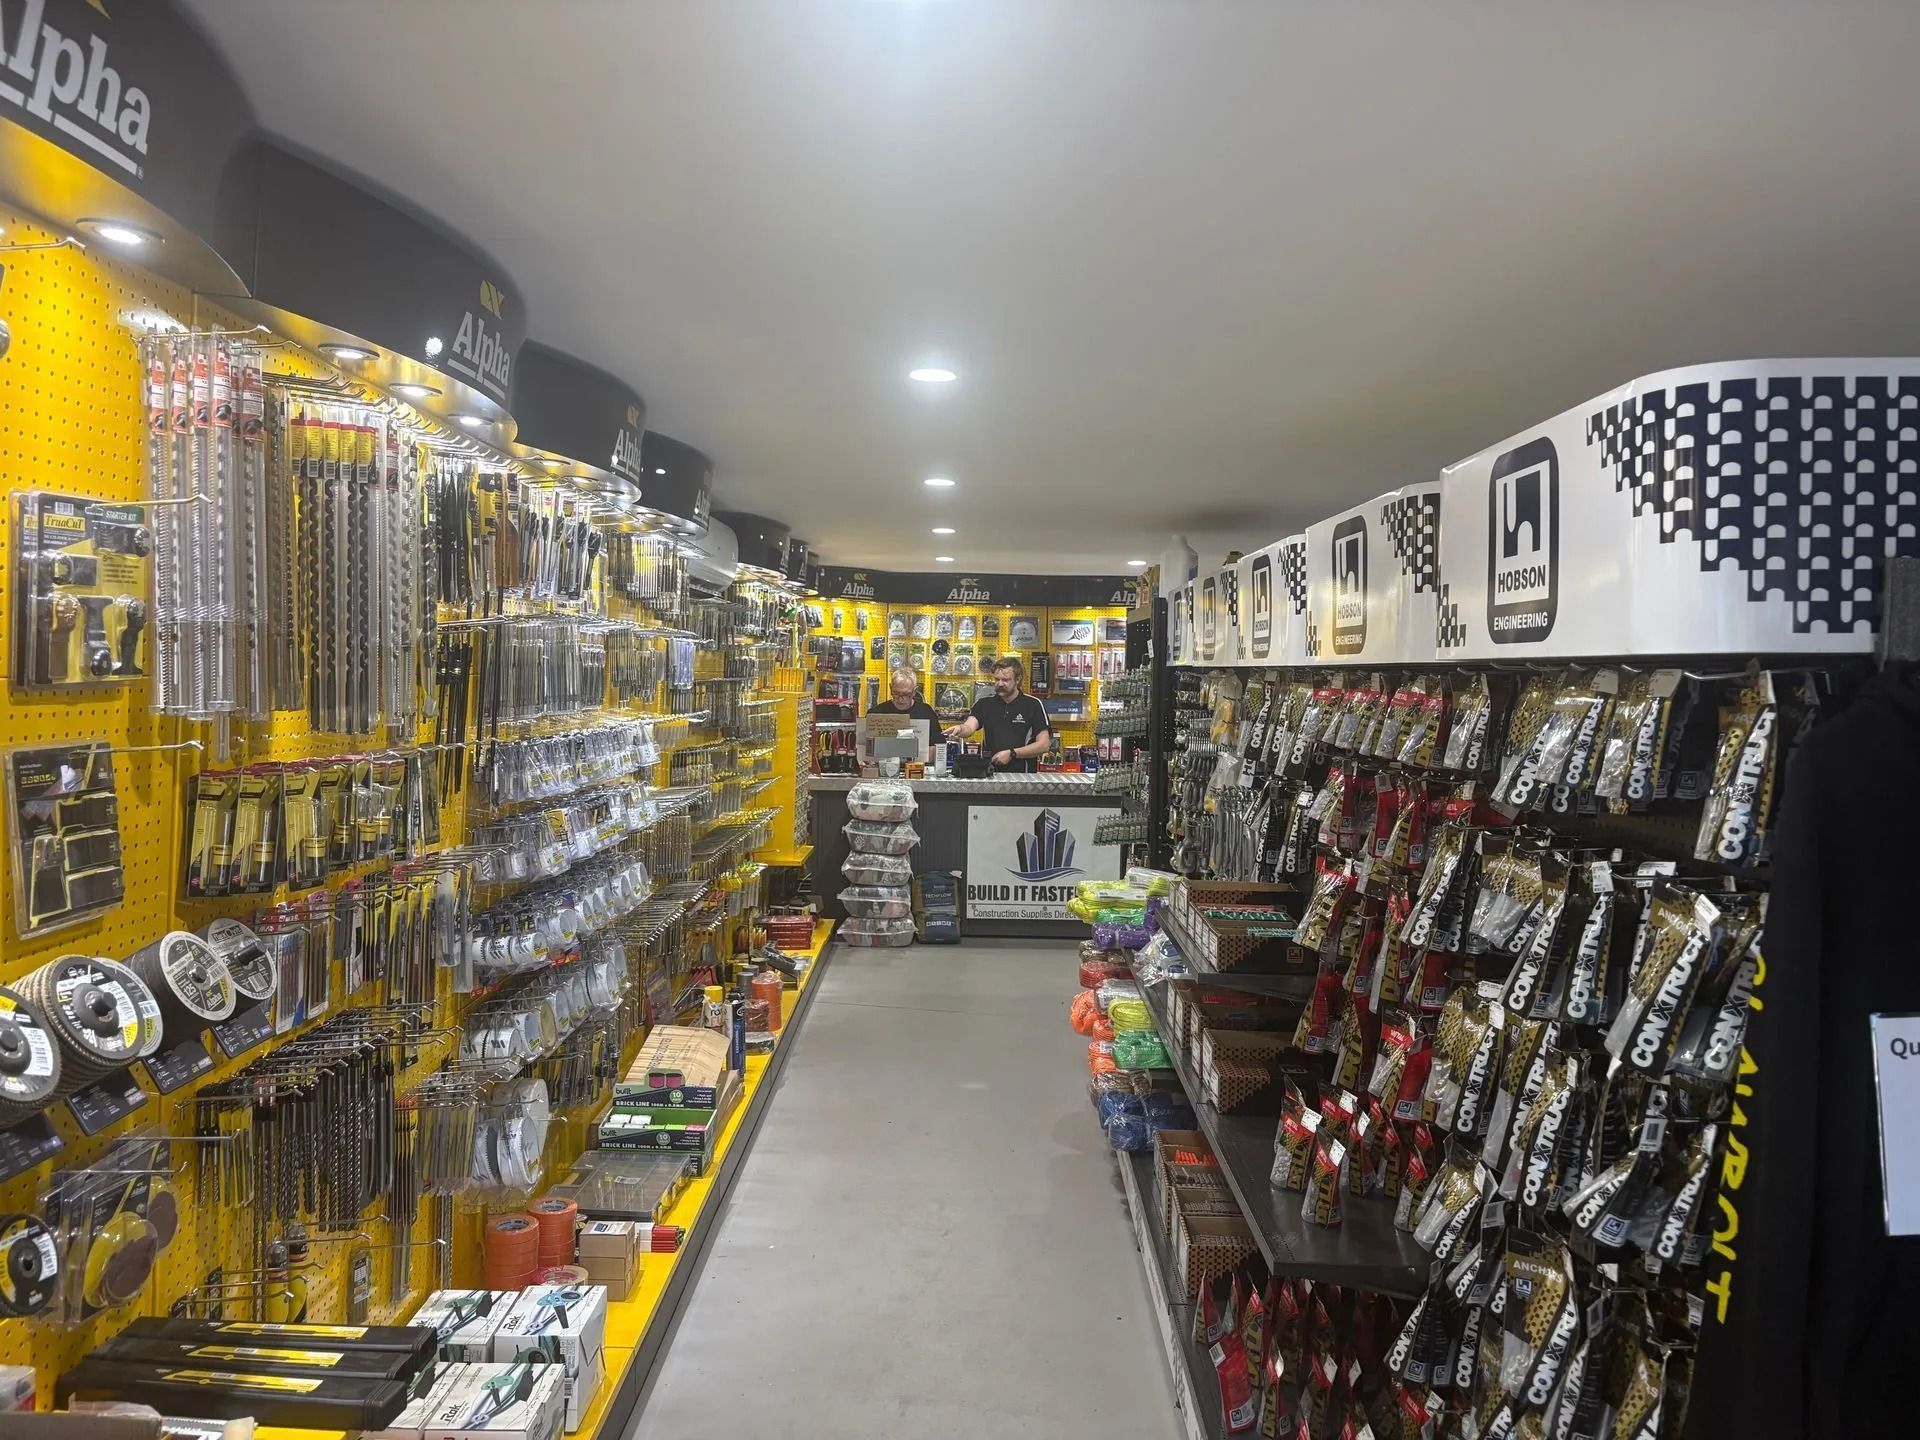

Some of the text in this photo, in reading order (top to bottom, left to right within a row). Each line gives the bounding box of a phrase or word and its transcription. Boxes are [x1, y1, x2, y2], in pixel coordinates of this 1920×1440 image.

[0, 0, 150, 155] lpha
[452, 311, 511, 387] Alpha
[105, 510, 137, 521] STARTER KIT
[1497, 564, 1546, 593] HOBSON
[843, 582, 874, 598] Alpha
[948, 588, 990, 604] Alpha
[1111, 590, 1136, 606] Alp
[1337, 601, 1362, 619] HOBSON
[1493, 611, 1548, 631] ENGINEERING
[1335, 633, 1363, 646] ENGINEERING
[968, 884, 1078, 902] BUILD IT FASTE
[973, 909, 1020, 918] Construction
[1021, 910, 1053, 919] Supplies
[1631, 933, 1706, 1067] CONXTRUCT
[440, 1403, 462, 1424] Rok
